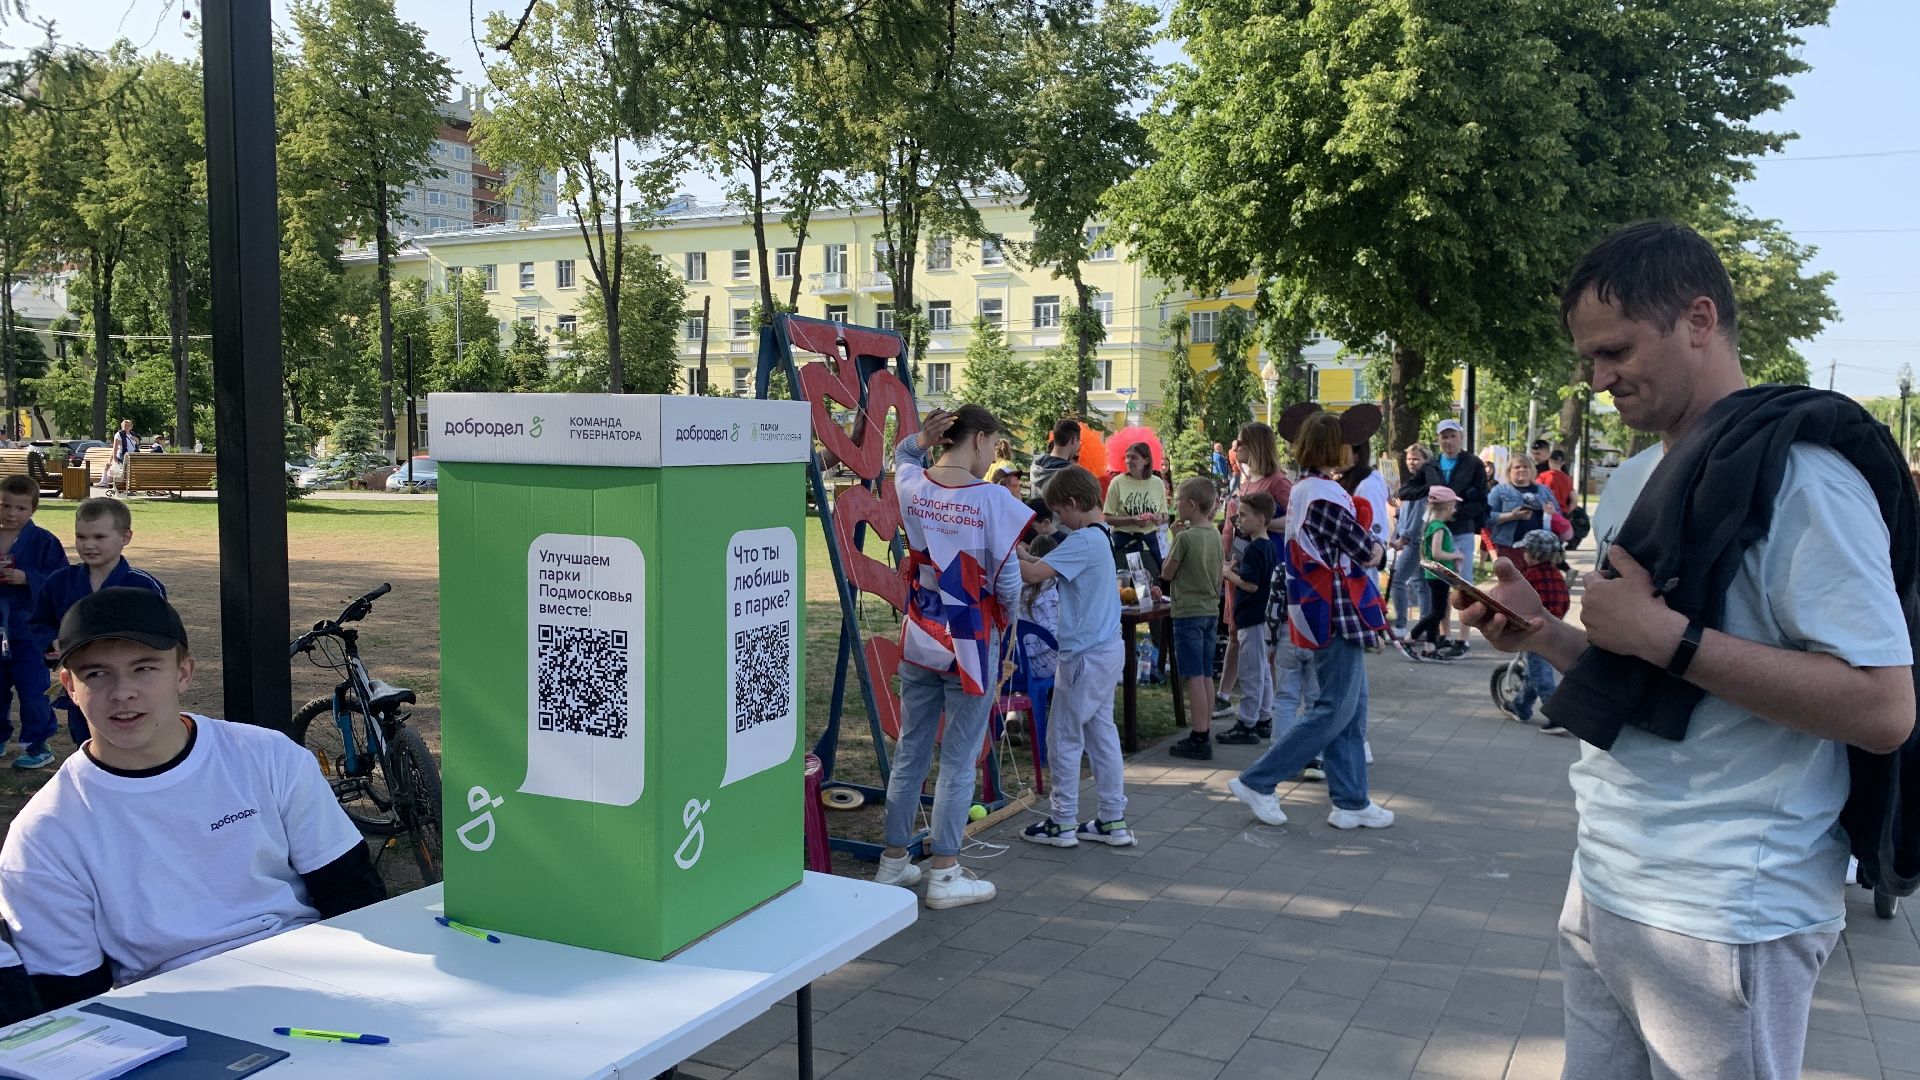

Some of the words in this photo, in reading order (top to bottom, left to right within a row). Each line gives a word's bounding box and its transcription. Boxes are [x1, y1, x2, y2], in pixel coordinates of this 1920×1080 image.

[444, 418, 524, 437] добродел
[569, 416, 622, 428] КОМАНДА
[760, 423, 780, 432] ПАРКИ
[570, 429, 642, 441] ГУБЕРНАТОРА
[676, 424, 728, 442] добродел
[912, 494, 981, 516] ВОЛОНТЕРЫ
[907, 506, 984, 530] ПОДМОСКОВЬЯ
[539, 549, 611, 567] Улучшаем
[734, 545, 759, 565] Что
[762, 545, 780, 562] ты
[539, 569, 581, 584] парки
[733, 567, 790, 592] любишь
[539, 584, 632, 603] Подмосковья
[734, 602, 742, 617] в
[745, 589, 790, 617] парке?
[539, 603, 592, 617] вместе!
[210, 808, 258, 832] доброде
